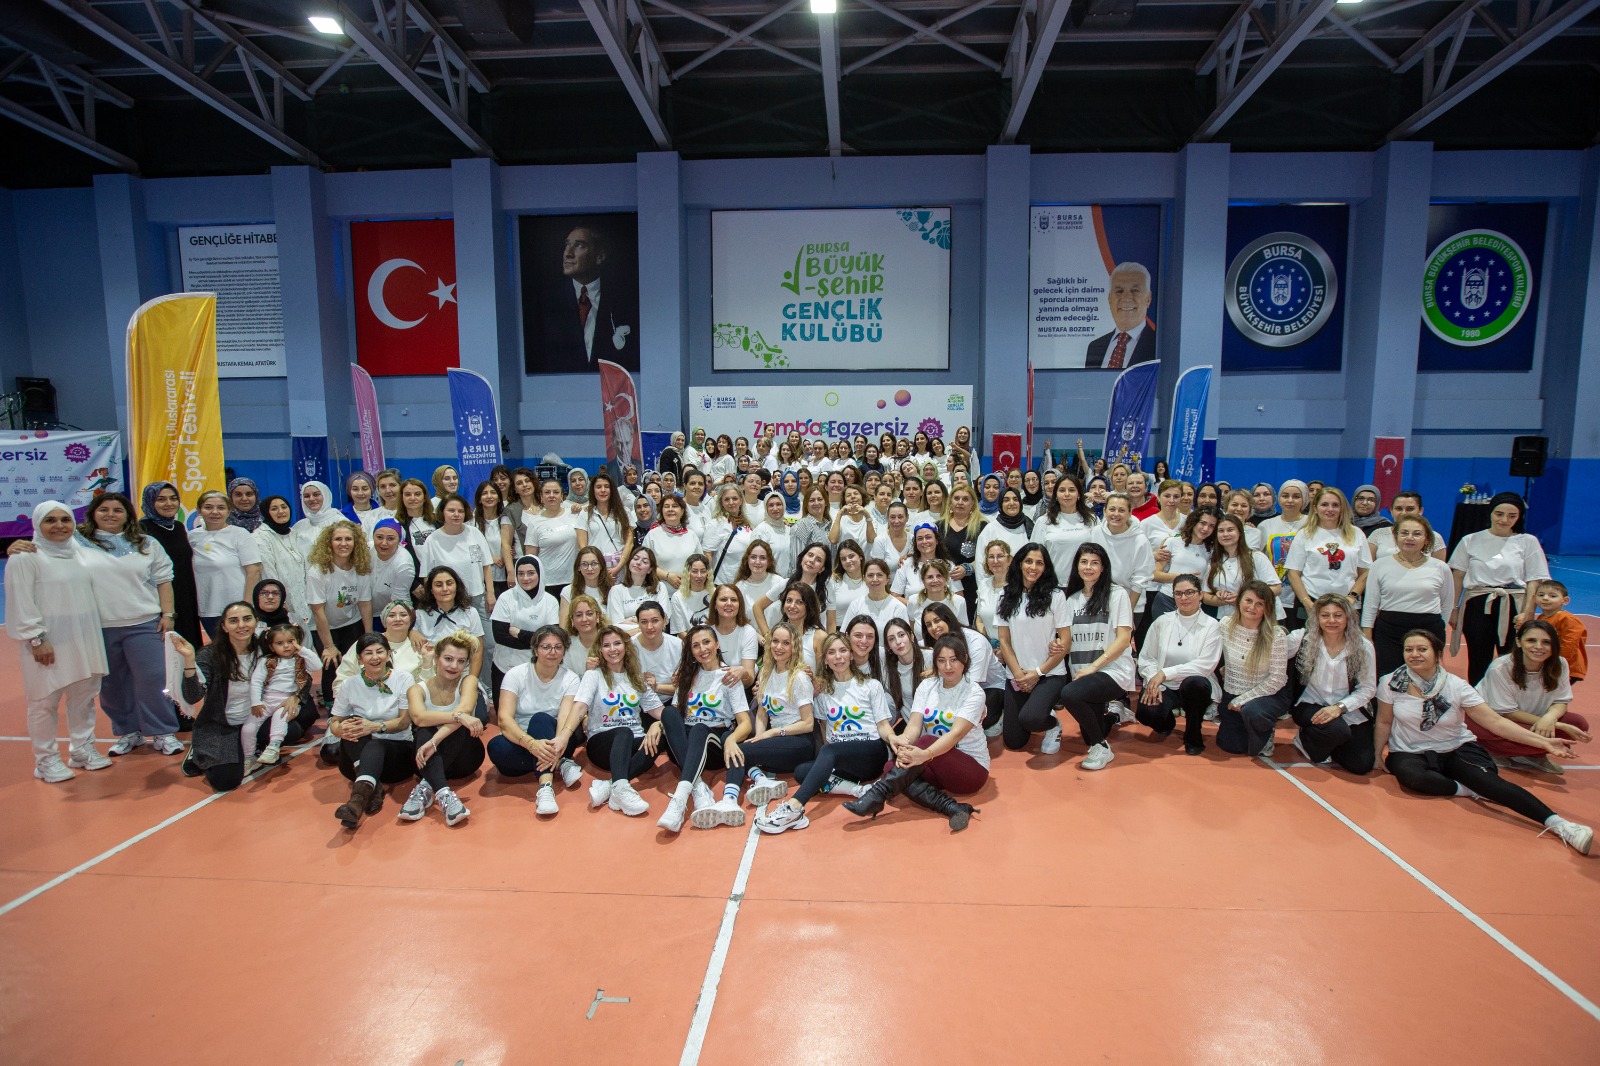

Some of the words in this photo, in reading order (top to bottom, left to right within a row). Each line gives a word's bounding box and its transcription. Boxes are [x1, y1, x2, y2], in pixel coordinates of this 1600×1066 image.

[189, 232, 242, 248] GENÇLİĞE
[1263, 246, 1302, 260] BURSA
[1047, 277, 1075, 285] Sağlıklı
[1425, 280, 1434, 308] BURSA
[1472, 237, 1522, 273] BELEDİYESPOR
[1033, 287, 1063, 295] gelecek
[1066, 286, 1079, 295] için
[1040, 296, 1098, 304] sporcularımızın
[782, 298, 883, 321] GENÇLİK
[1063, 314, 1099, 322] edeceğiz.
[1238, 286, 1282, 334] BÜYÜKŞEHİR
[1284, 285, 1324, 333] BELEDİYESİ
[782, 322, 882, 342] KULÜBÜ
[1461, 329, 1480, 337] 1980
[165, 370, 178, 436] Uluslararası
[179, 371, 198, 444] Festivali
[754, 420, 822, 438] Zmba
[828, 417, 909, 440] Egzersiz
[1186, 409, 1198, 450] Festivali
[182, 448, 207, 492] Spor
[1185, 452, 1194, 476] Spor
